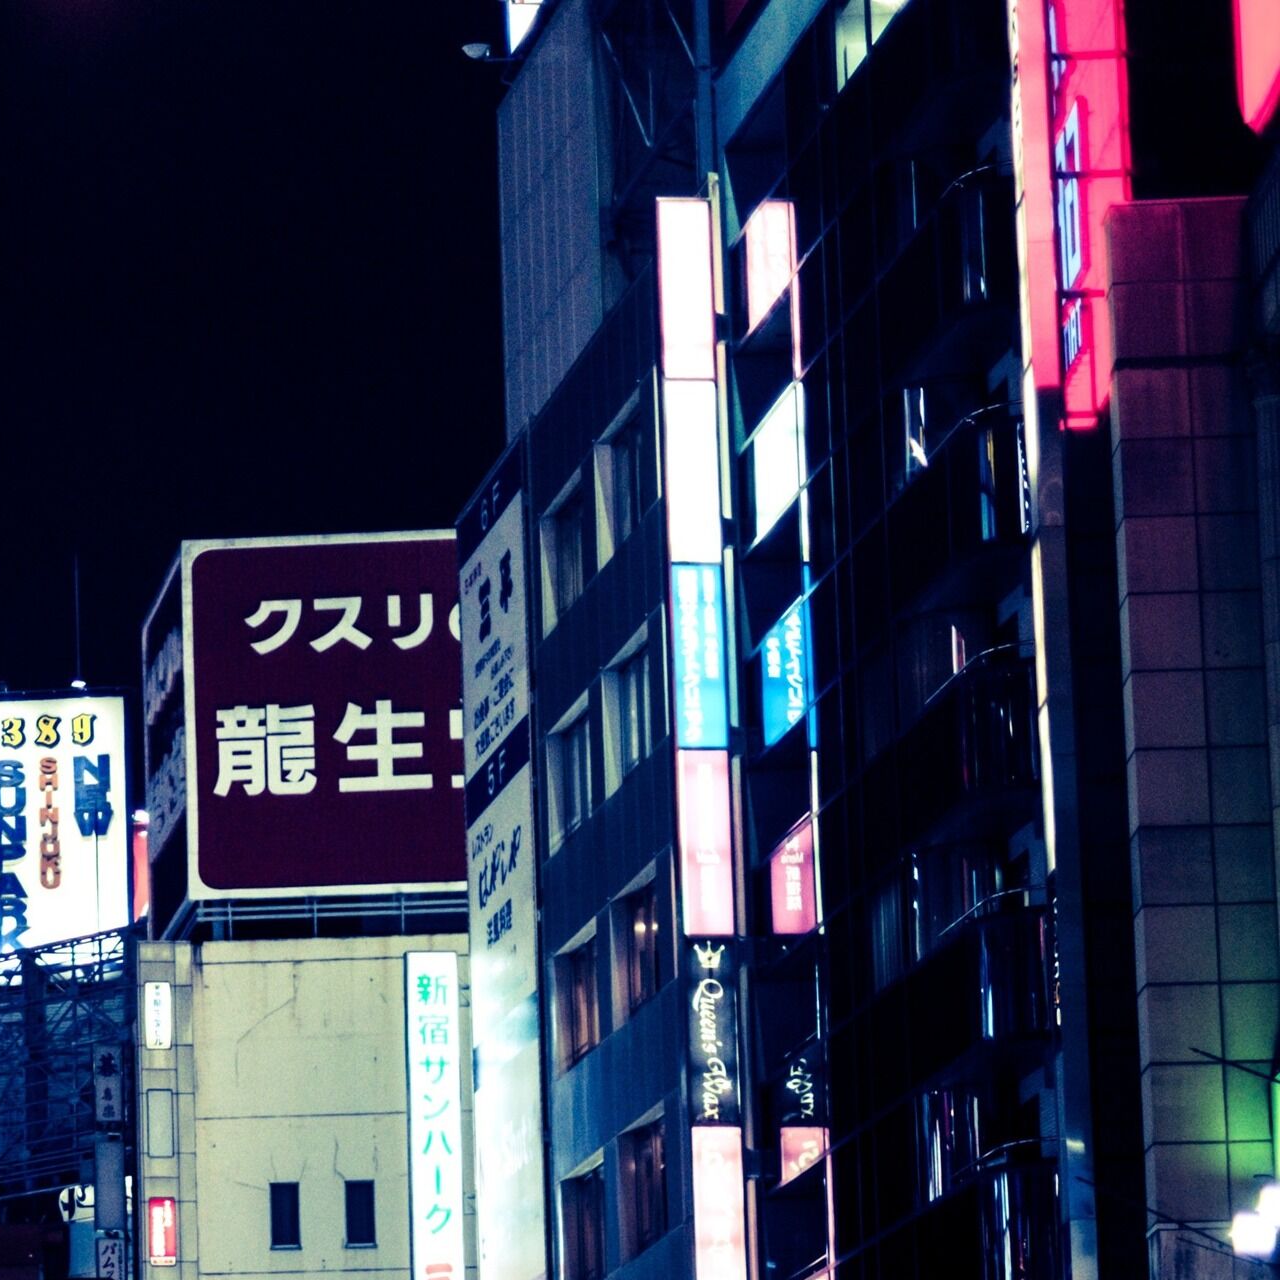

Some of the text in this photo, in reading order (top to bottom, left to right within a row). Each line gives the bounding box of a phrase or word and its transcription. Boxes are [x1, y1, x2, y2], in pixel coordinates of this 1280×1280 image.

[243, 591, 461, 657] クスリ
[1, 713, 97, 750] 389
[212, 699, 465, 798] 龍生
[487, 748, 506, 795] 5F
